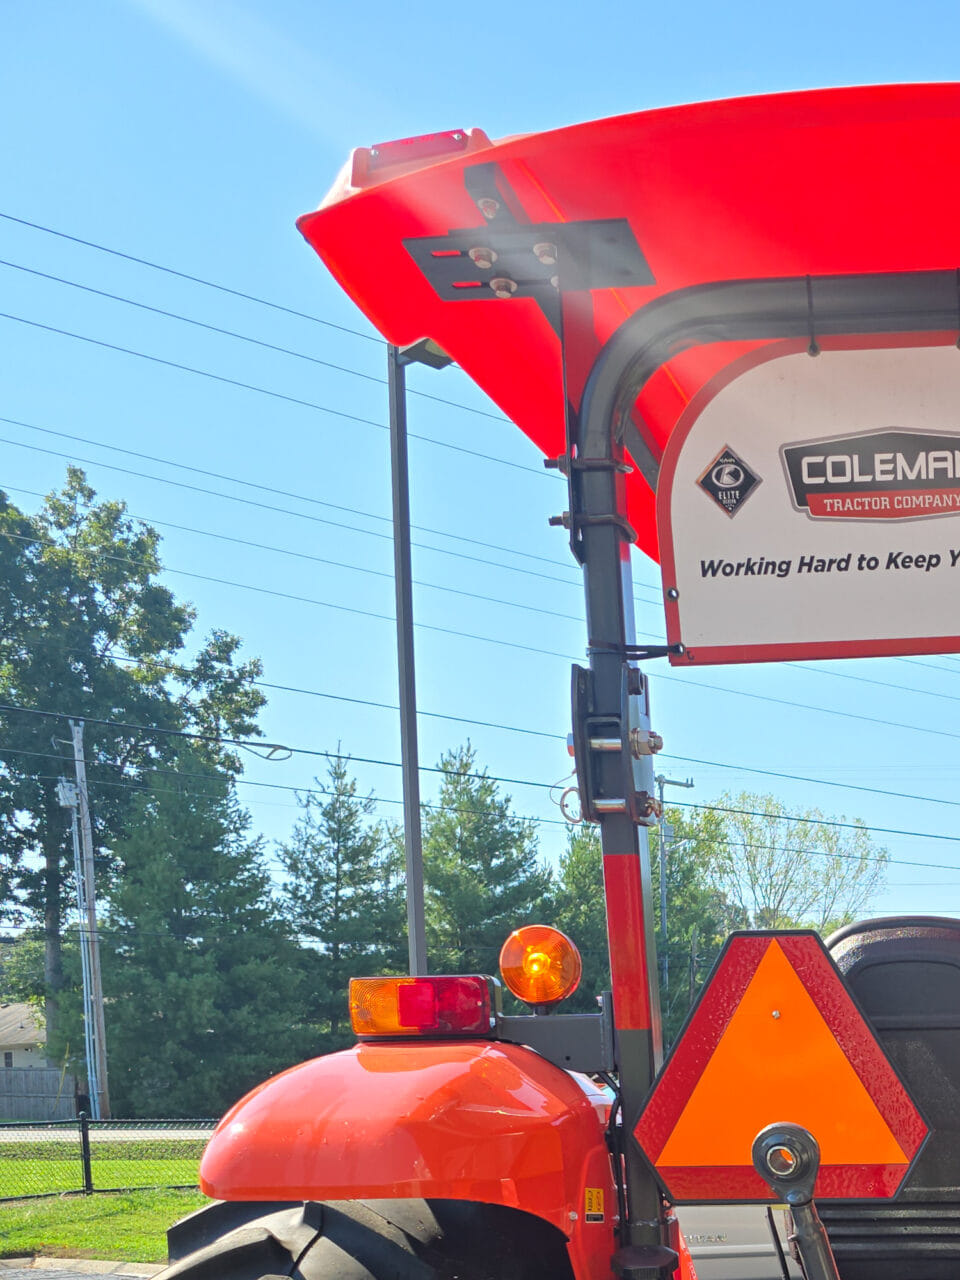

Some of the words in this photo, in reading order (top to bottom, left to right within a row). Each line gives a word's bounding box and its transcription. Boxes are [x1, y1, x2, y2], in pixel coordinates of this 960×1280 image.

[718, 490, 740, 500] ELITE
[823, 496, 890, 512] TRACTOR
[700, 556, 793, 578] Working
[797, 553, 853, 574] Hard
[857, 553, 880, 571] to
[885, 551, 942, 572] Keep
[684, 1232, 728, 1243] ITAN
